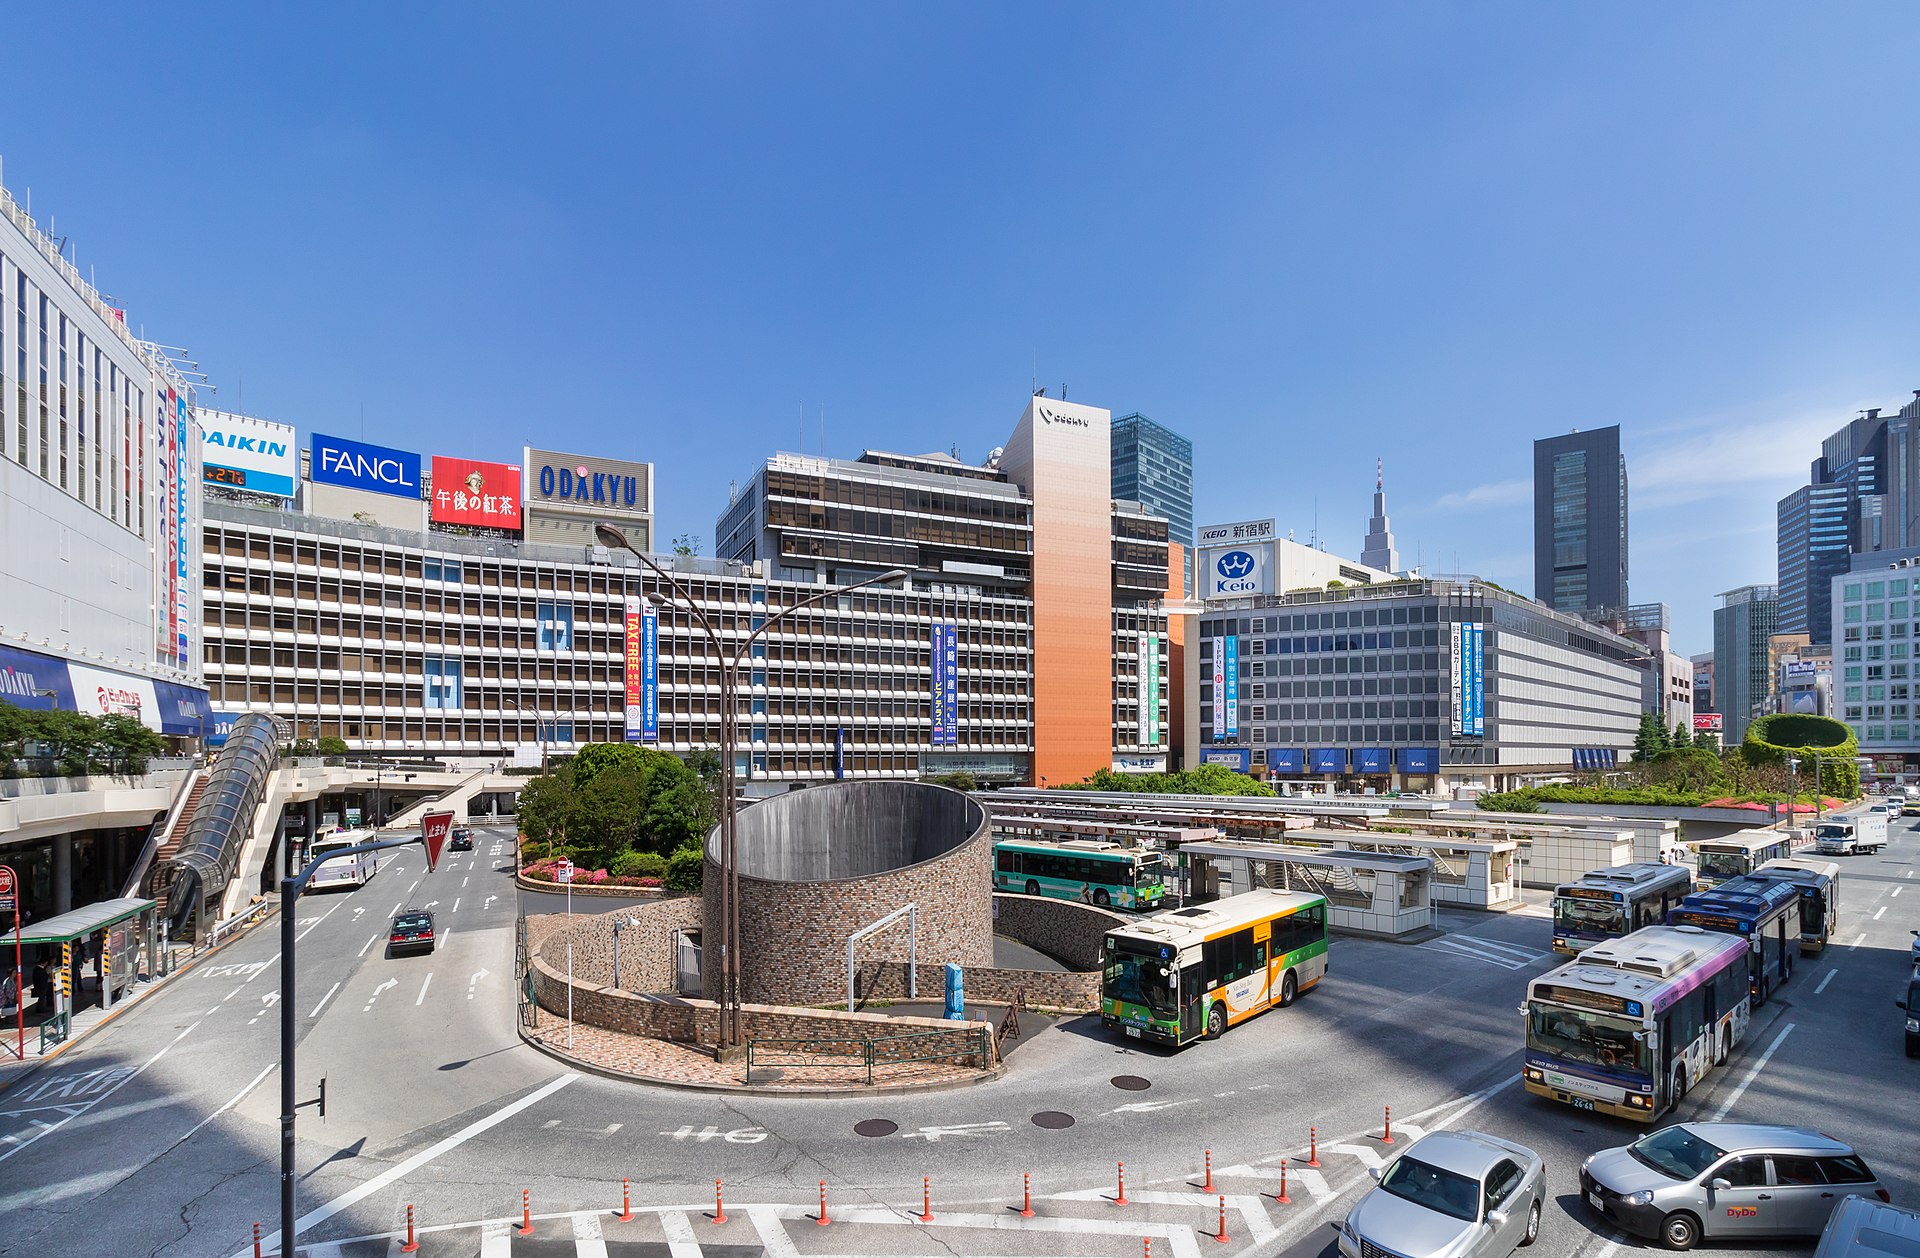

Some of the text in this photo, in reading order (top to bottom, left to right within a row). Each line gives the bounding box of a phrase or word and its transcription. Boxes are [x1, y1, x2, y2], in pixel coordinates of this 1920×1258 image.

[322, 447, 414, 487] FANCL
[539, 465, 636, 506] ODAKYU
[1203, 522, 1271, 540] KEIO 新宿駅
[1217, 578, 1256, 593] Keio
[627, 616, 639, 639] TAX
[627, 642, 639, 671] FREE
[427, 823, 447, 838] 止まれ
[1546, 1062, 1560, 1070] BUS
[1567, 1080, 1600, 1092] ノンステップバス
[1727, 1208, 1757, 1221] DyDo
